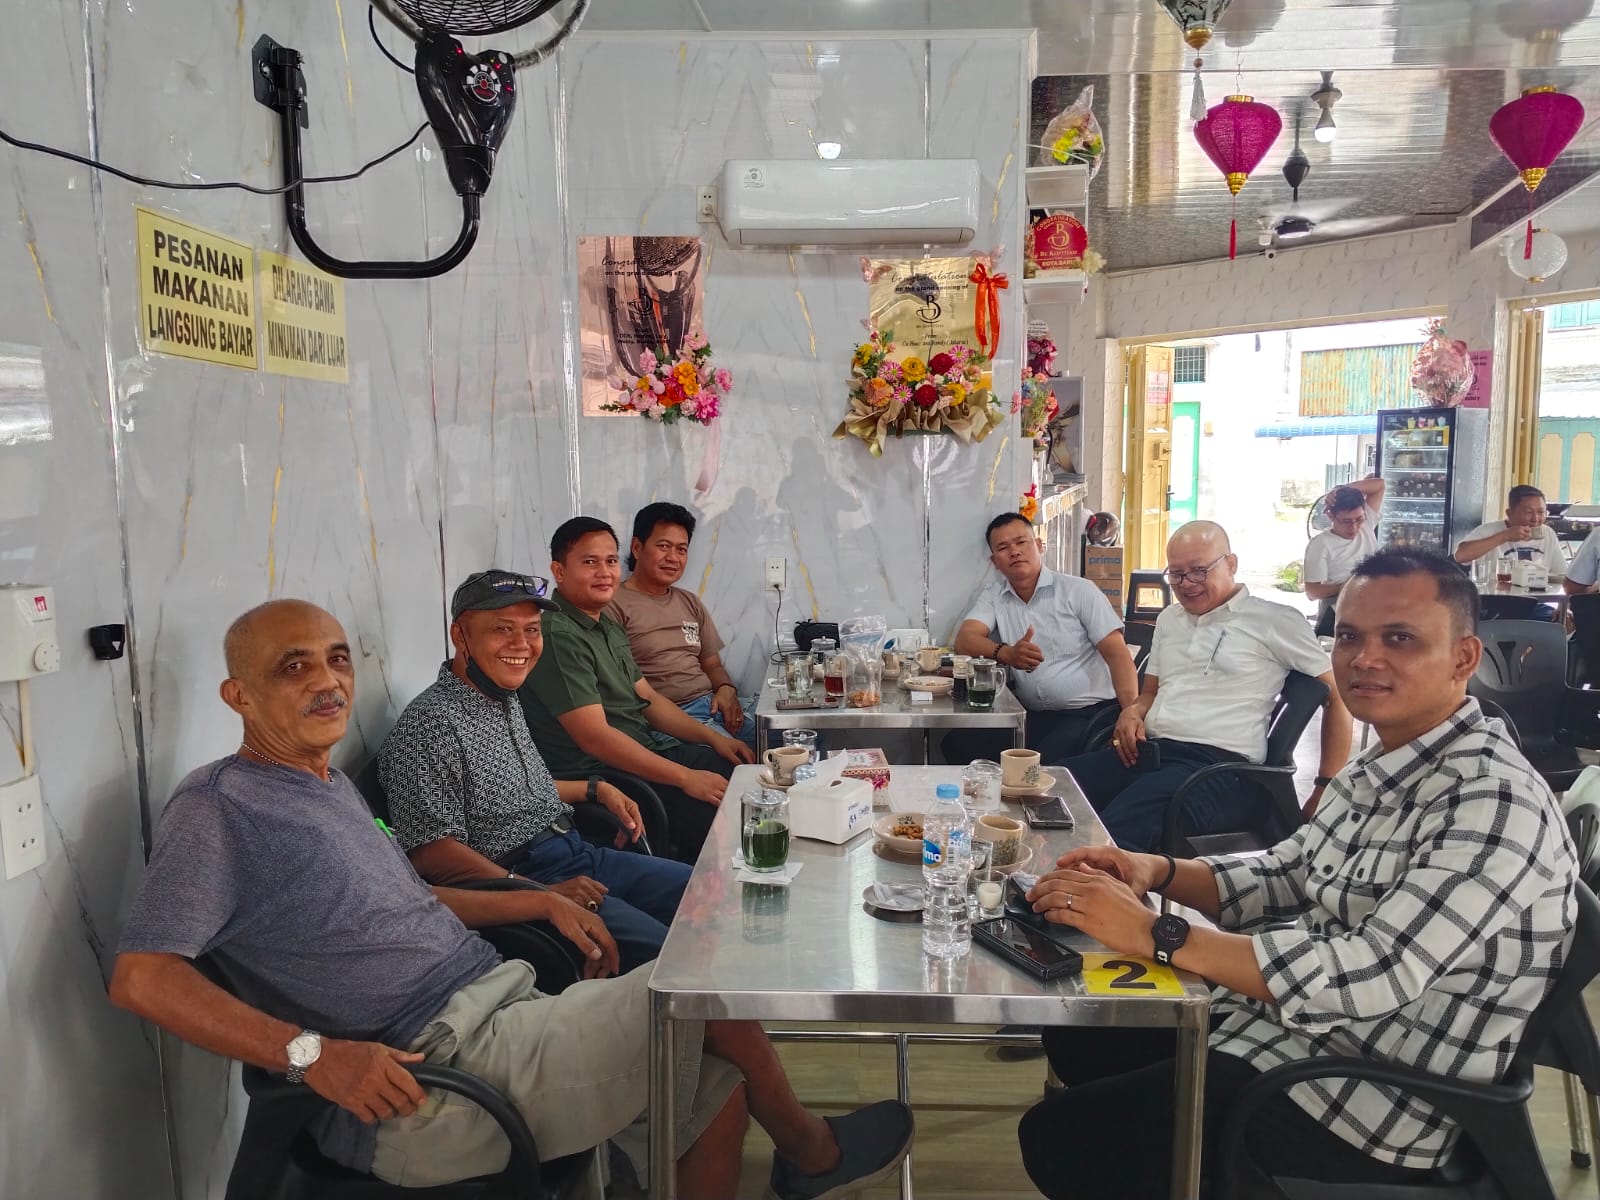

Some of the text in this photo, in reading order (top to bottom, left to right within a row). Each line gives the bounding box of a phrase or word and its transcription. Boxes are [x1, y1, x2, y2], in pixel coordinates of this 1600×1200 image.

[153, 229, 244, 283] PESANAN
[152, 266, 249, 317] MAKANAN
[272, 264, 336, 315] DILARANG BAWA
[916, 285, 935, 293] grand
[148, 304, 254, 358] LANGSUNG BAYAR
[268, 320, 346, 369] MINUMAN DARI LUAR
[1088, 557, 1121, 565] prima
[1103, 960, 1157, 989] 2
